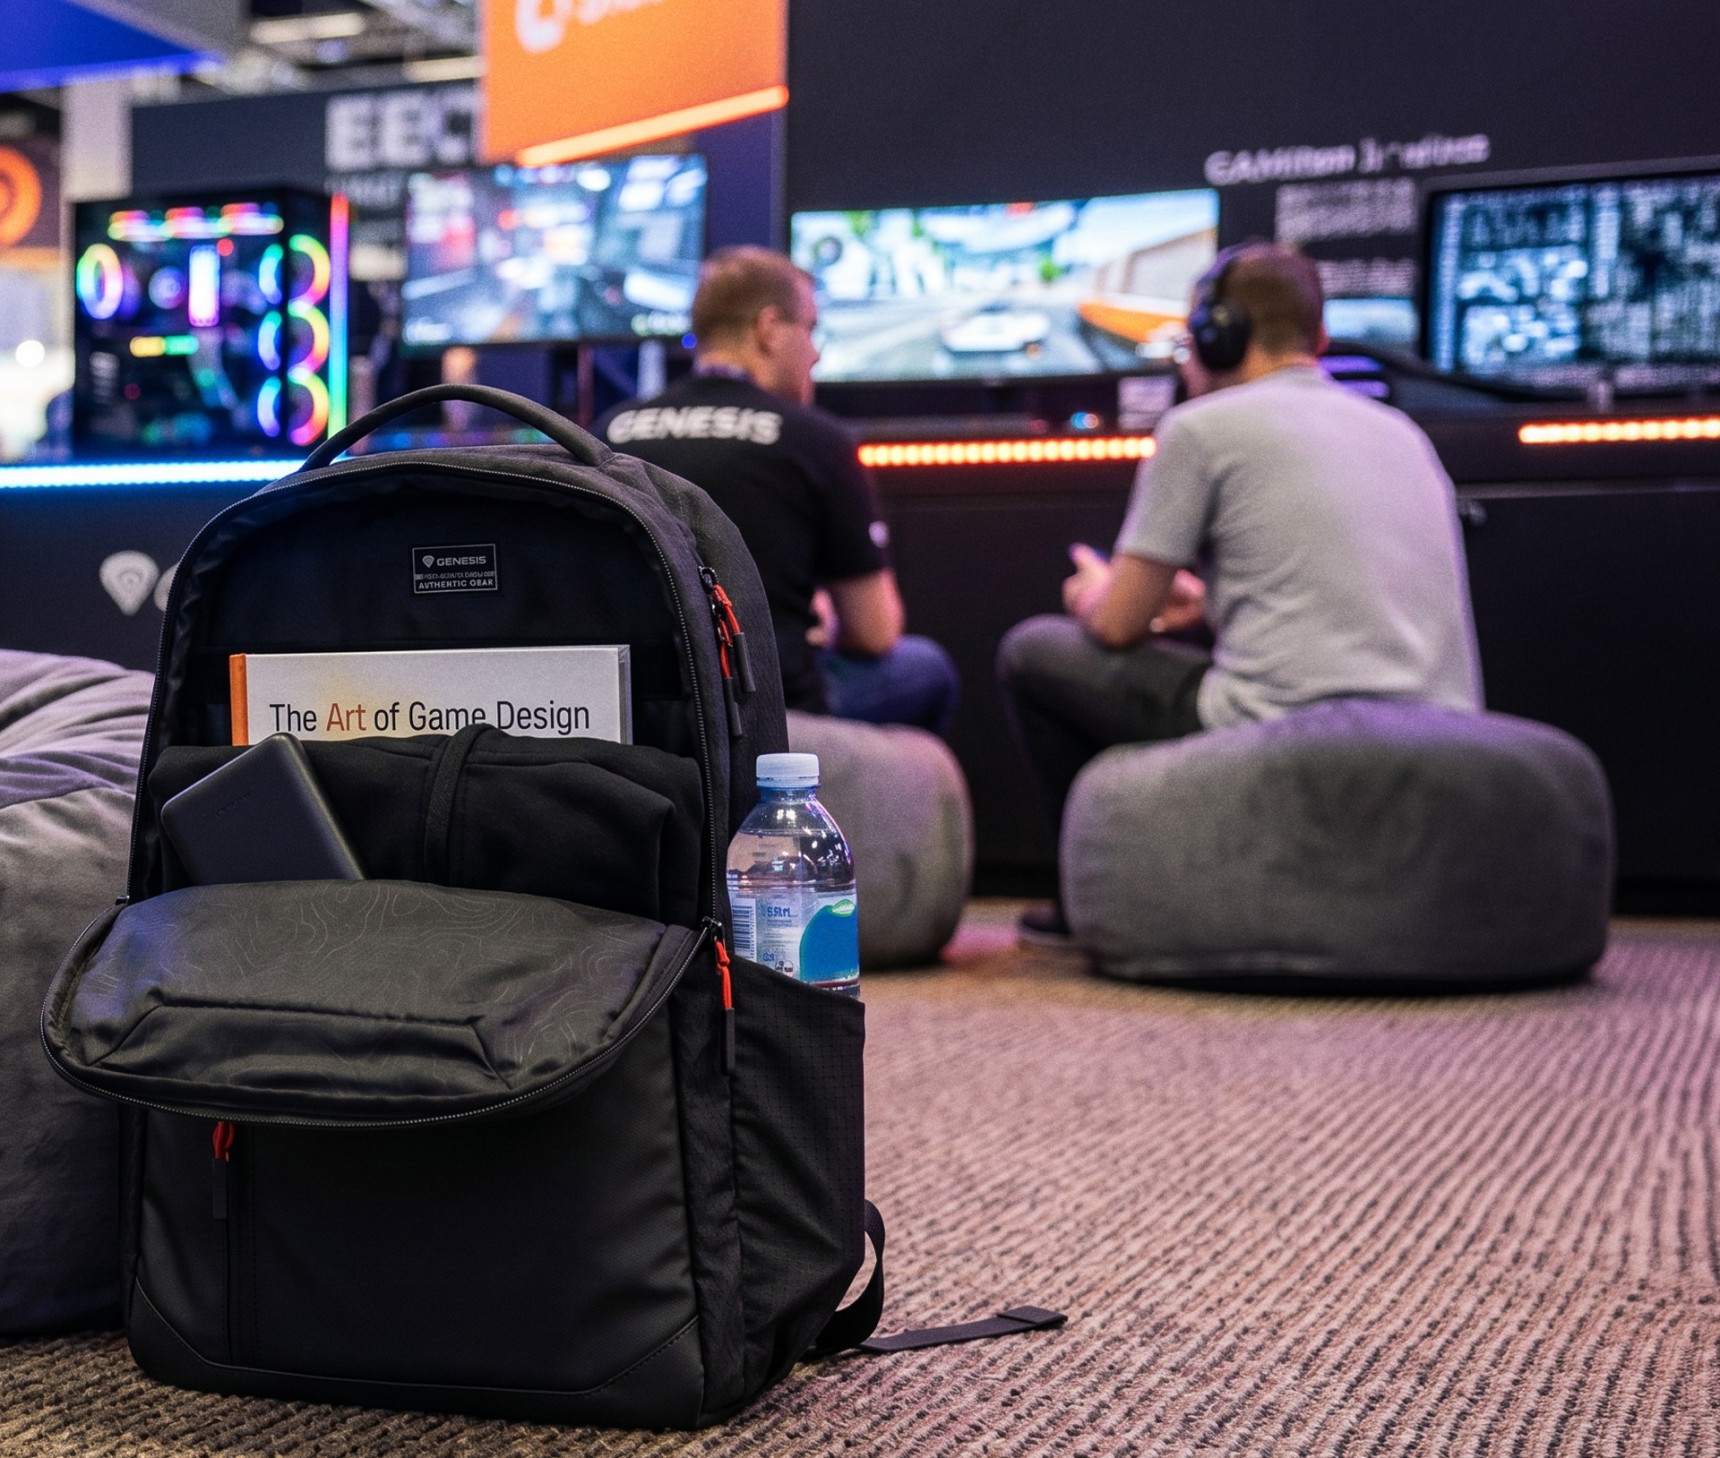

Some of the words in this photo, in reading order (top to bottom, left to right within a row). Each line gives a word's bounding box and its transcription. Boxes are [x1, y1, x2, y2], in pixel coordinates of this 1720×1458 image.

[607, 406, 783, 445] GENESIS
[436, 555, 487, 567] GENESIS
[269, 703, 317, 732] The
[326, 702, 367, 732] Art
[374, 701, 400, 731] of
[408, 701, 486, 731] Game
[496, 700, 590, 736] Design
